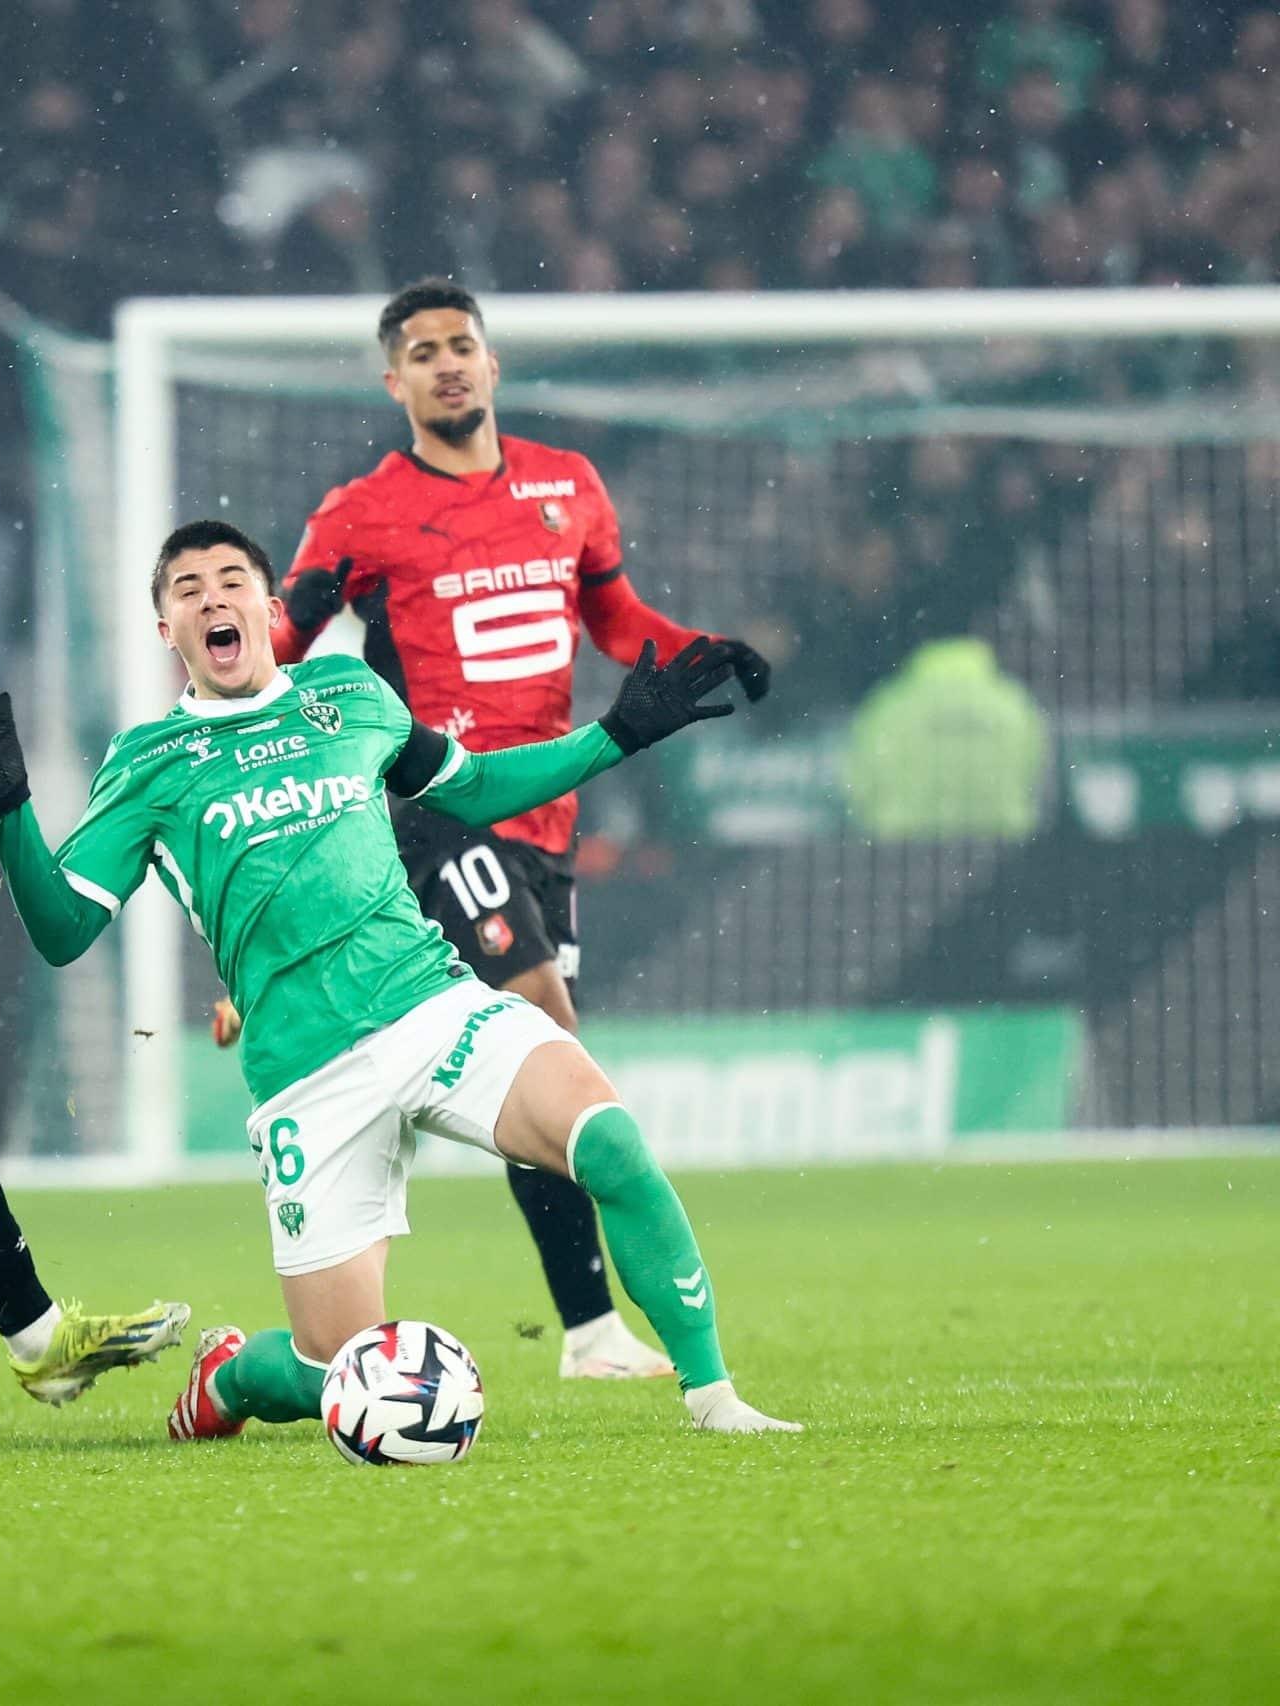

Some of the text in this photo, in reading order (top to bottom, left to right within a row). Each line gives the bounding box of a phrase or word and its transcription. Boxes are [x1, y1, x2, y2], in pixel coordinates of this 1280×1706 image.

[432, 557, 576, 599] SAMSIC
[234, 735, 308, 766] Loire
[240, 764, 250, 773] LE
[231, 774, 370, 828] Kelyps
[439, 844, 511, 921] 10
